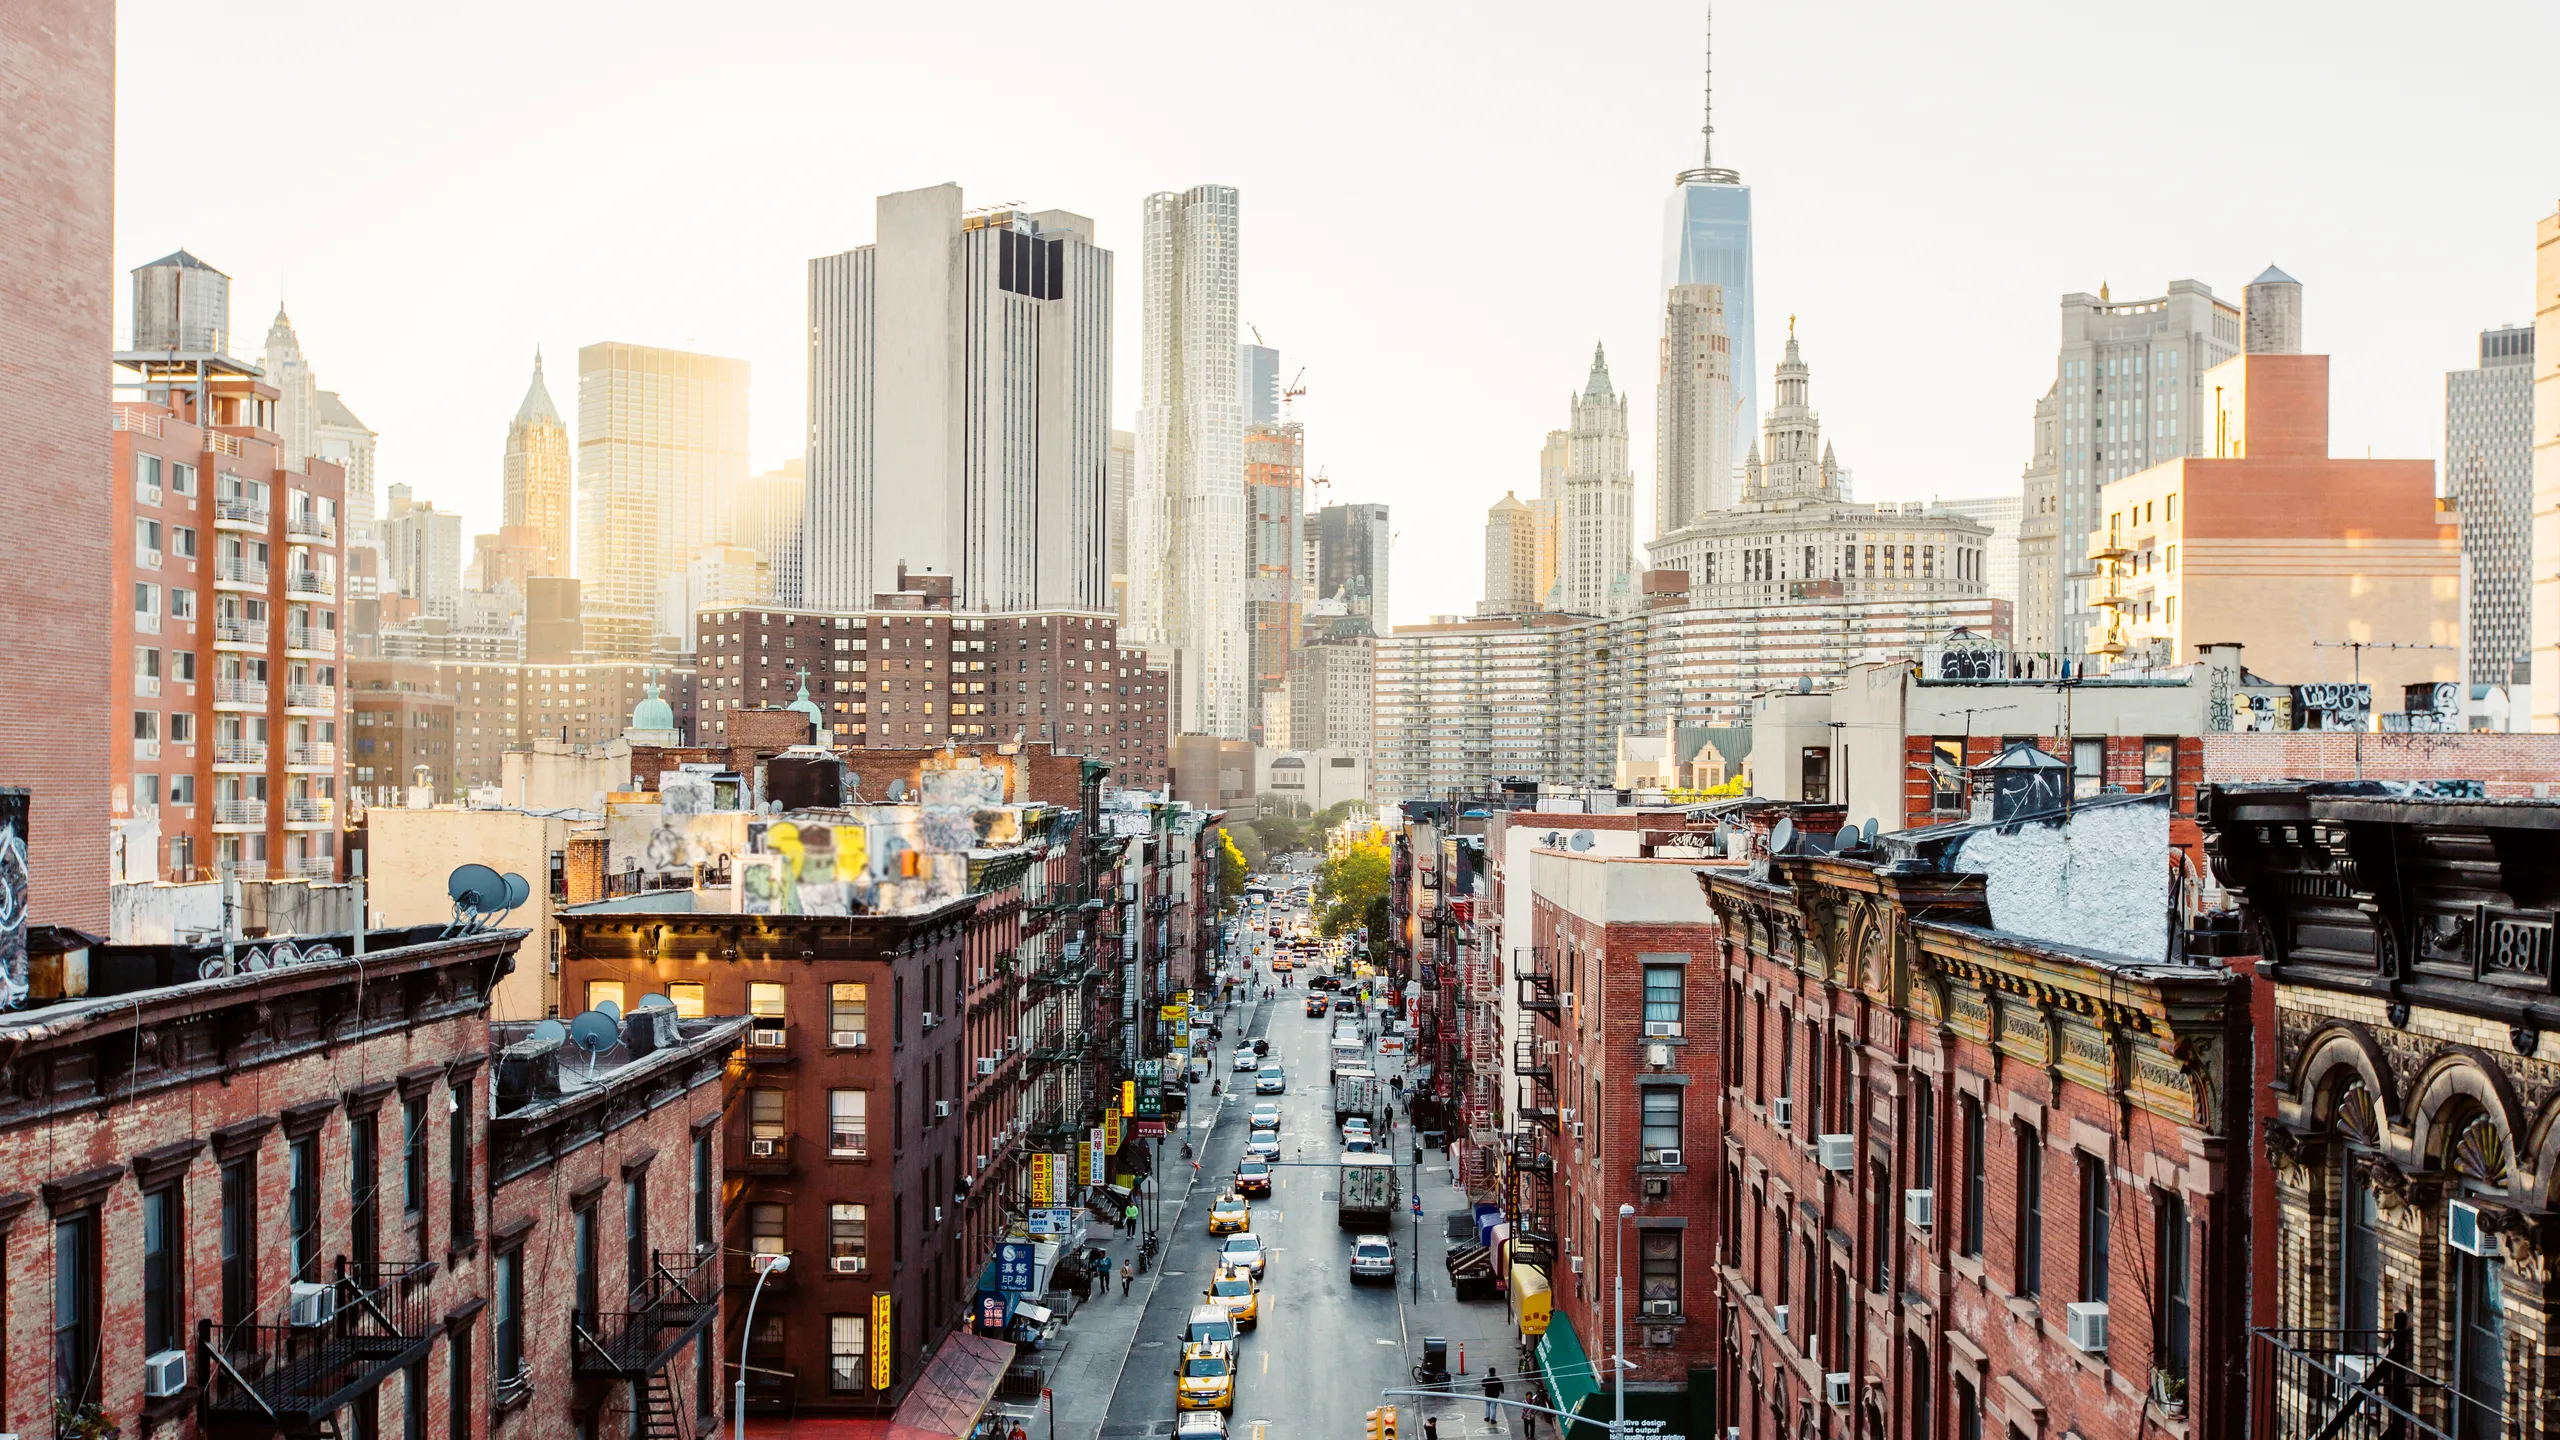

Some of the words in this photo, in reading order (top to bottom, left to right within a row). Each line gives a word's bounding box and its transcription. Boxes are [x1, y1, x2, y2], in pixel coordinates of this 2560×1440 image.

[2489, 921, 2542, 974] 1891
[1001, 1275, 1028, 1287] 印刷
[1640, 1419, 1667, 1428] design
[1634, 1426, 1660, 1434] output
